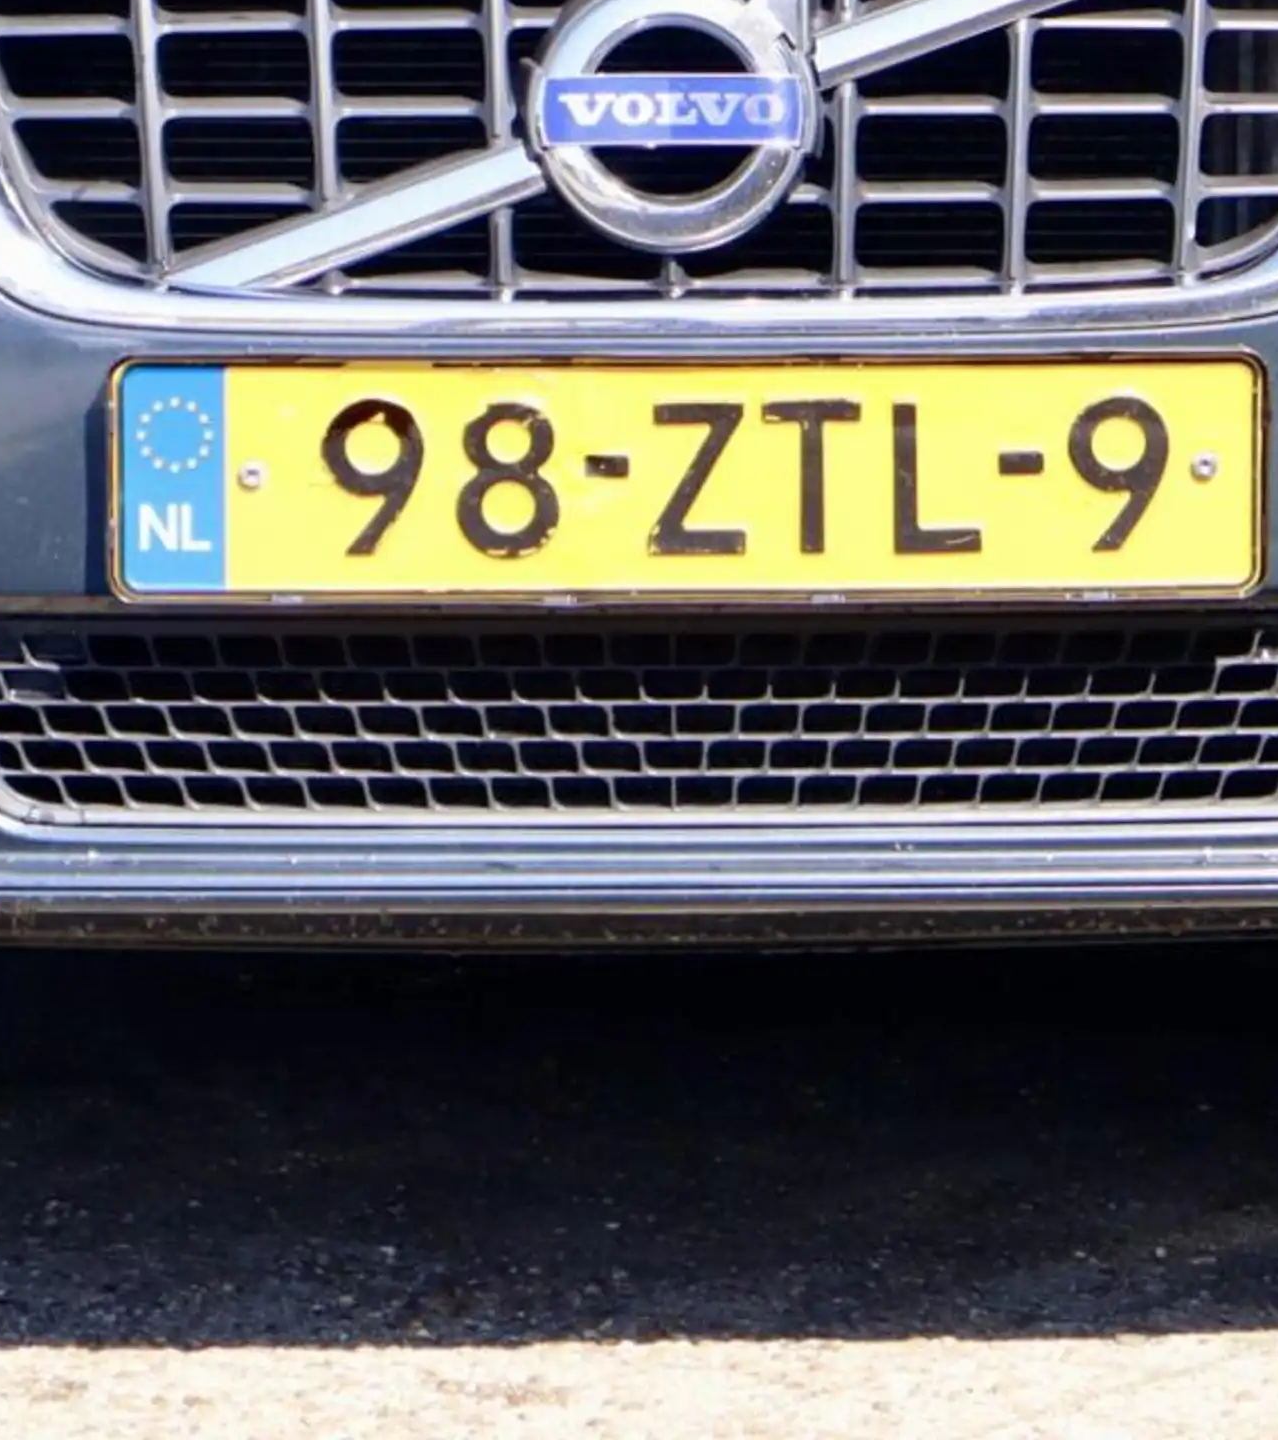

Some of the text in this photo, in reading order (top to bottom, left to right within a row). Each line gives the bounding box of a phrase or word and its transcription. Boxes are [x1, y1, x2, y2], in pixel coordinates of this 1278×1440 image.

[559, 92, 786, 126] VOLVO
[322, 398, 1168, 557] 98-ZTL-9
[137, 503, 212, 551] NL
